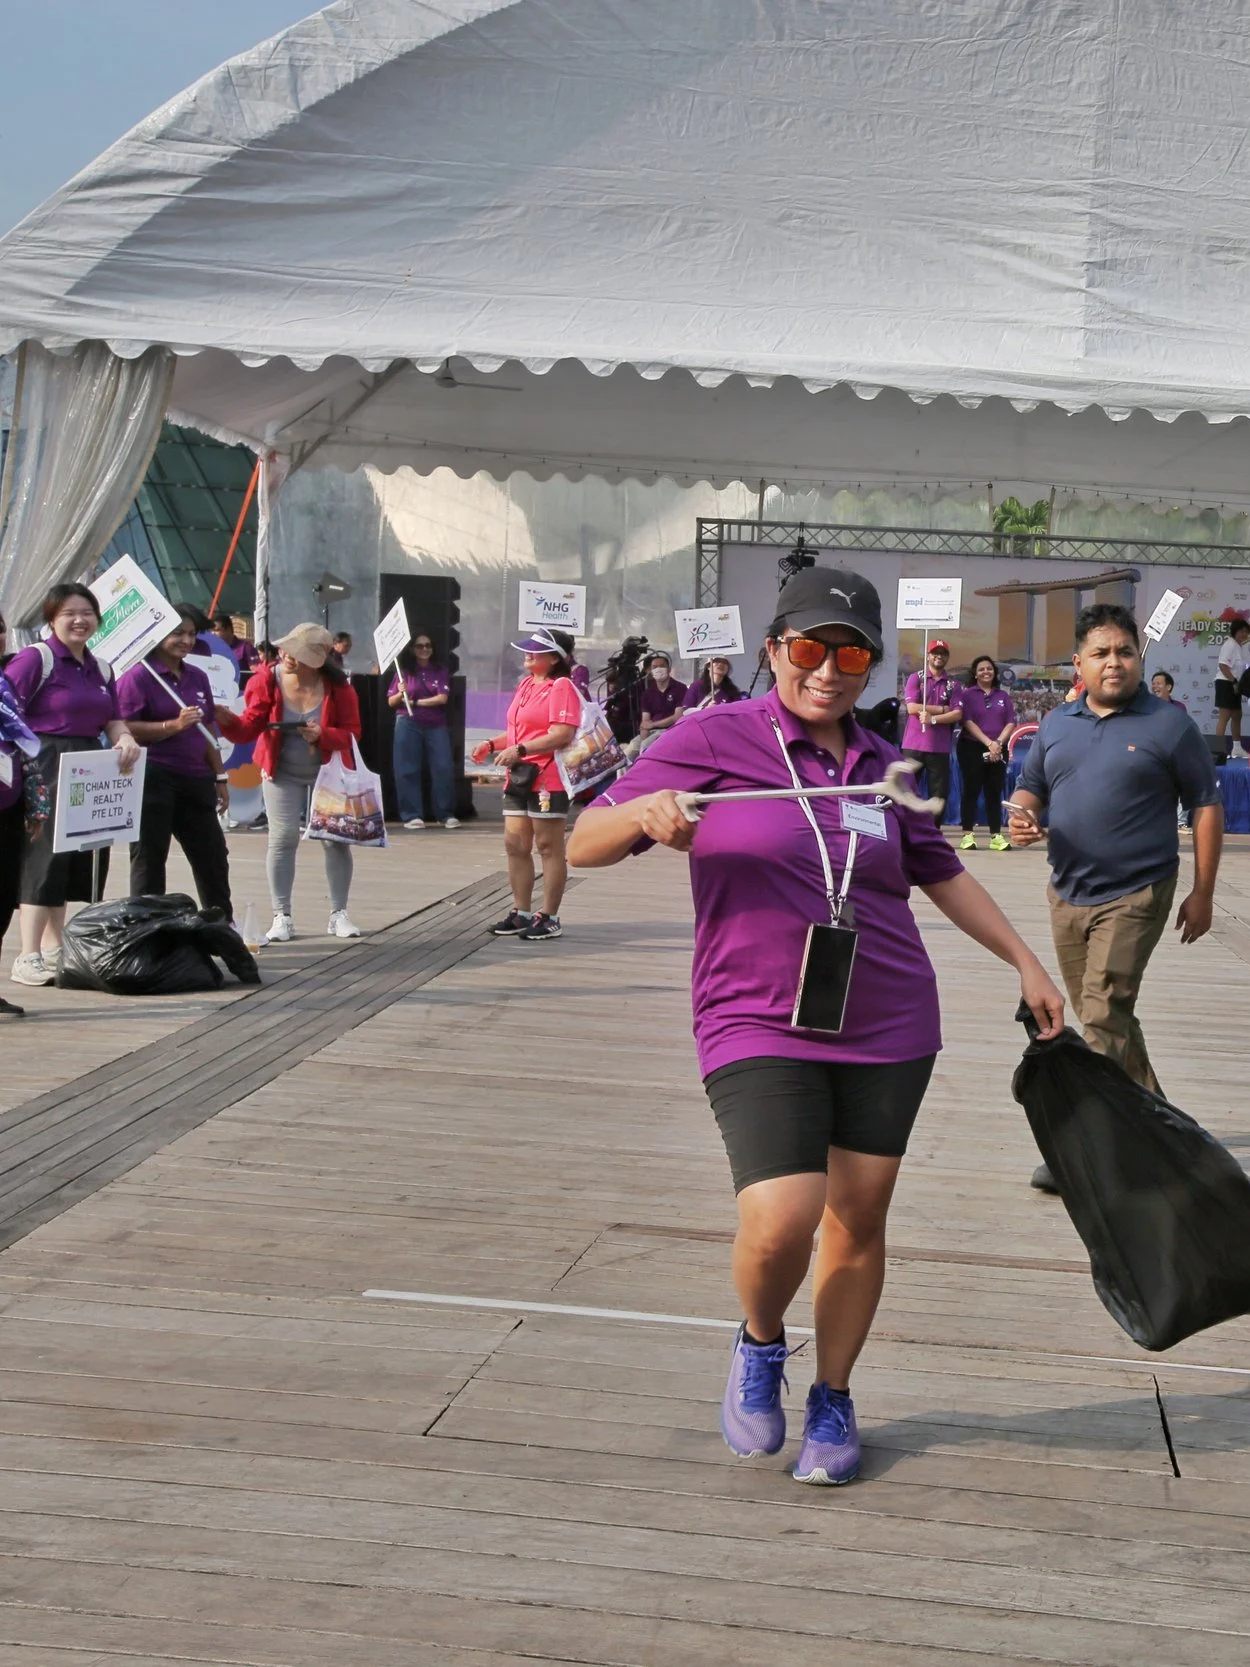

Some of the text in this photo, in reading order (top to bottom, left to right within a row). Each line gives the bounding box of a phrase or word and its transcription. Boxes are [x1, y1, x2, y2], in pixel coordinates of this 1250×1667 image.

[543, 601, 569, 613] NHG
[542, 611, 568, 621] Health
[1177, 620, 1211, 632] READY
[85, 778, 133, 792] CHIAN TECK
[93, 793, 124, 805] REALTY
[91, 806, 123, 819] PTE LTD
